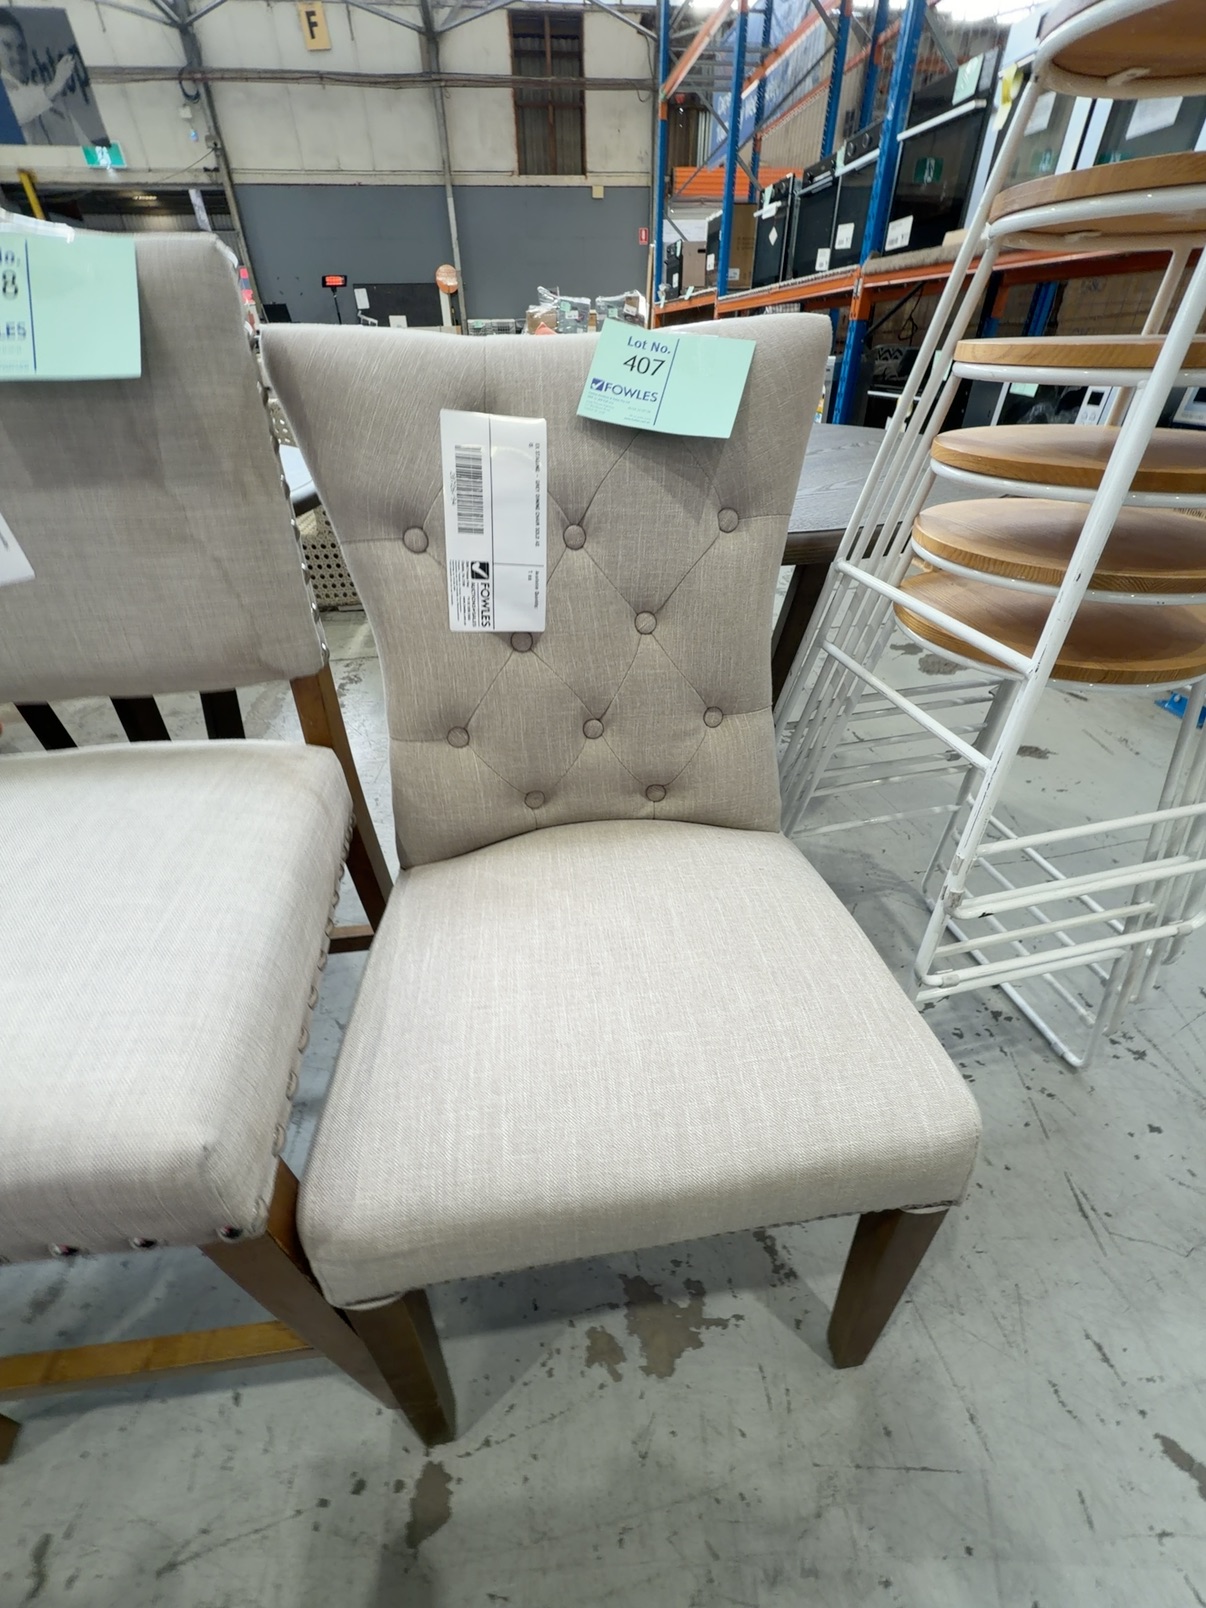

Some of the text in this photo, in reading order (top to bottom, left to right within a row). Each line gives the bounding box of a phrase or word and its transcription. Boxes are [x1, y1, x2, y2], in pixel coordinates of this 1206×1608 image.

[305, 10, 318, 39] F
[0, 321, 27, 341] ES
[627, 336, 671, 355] Lot No.
[623, 354, 665, 376] 407
[604, 382, 658, 403] FOWLES
[480, 582, 491, 627] FOWLES
